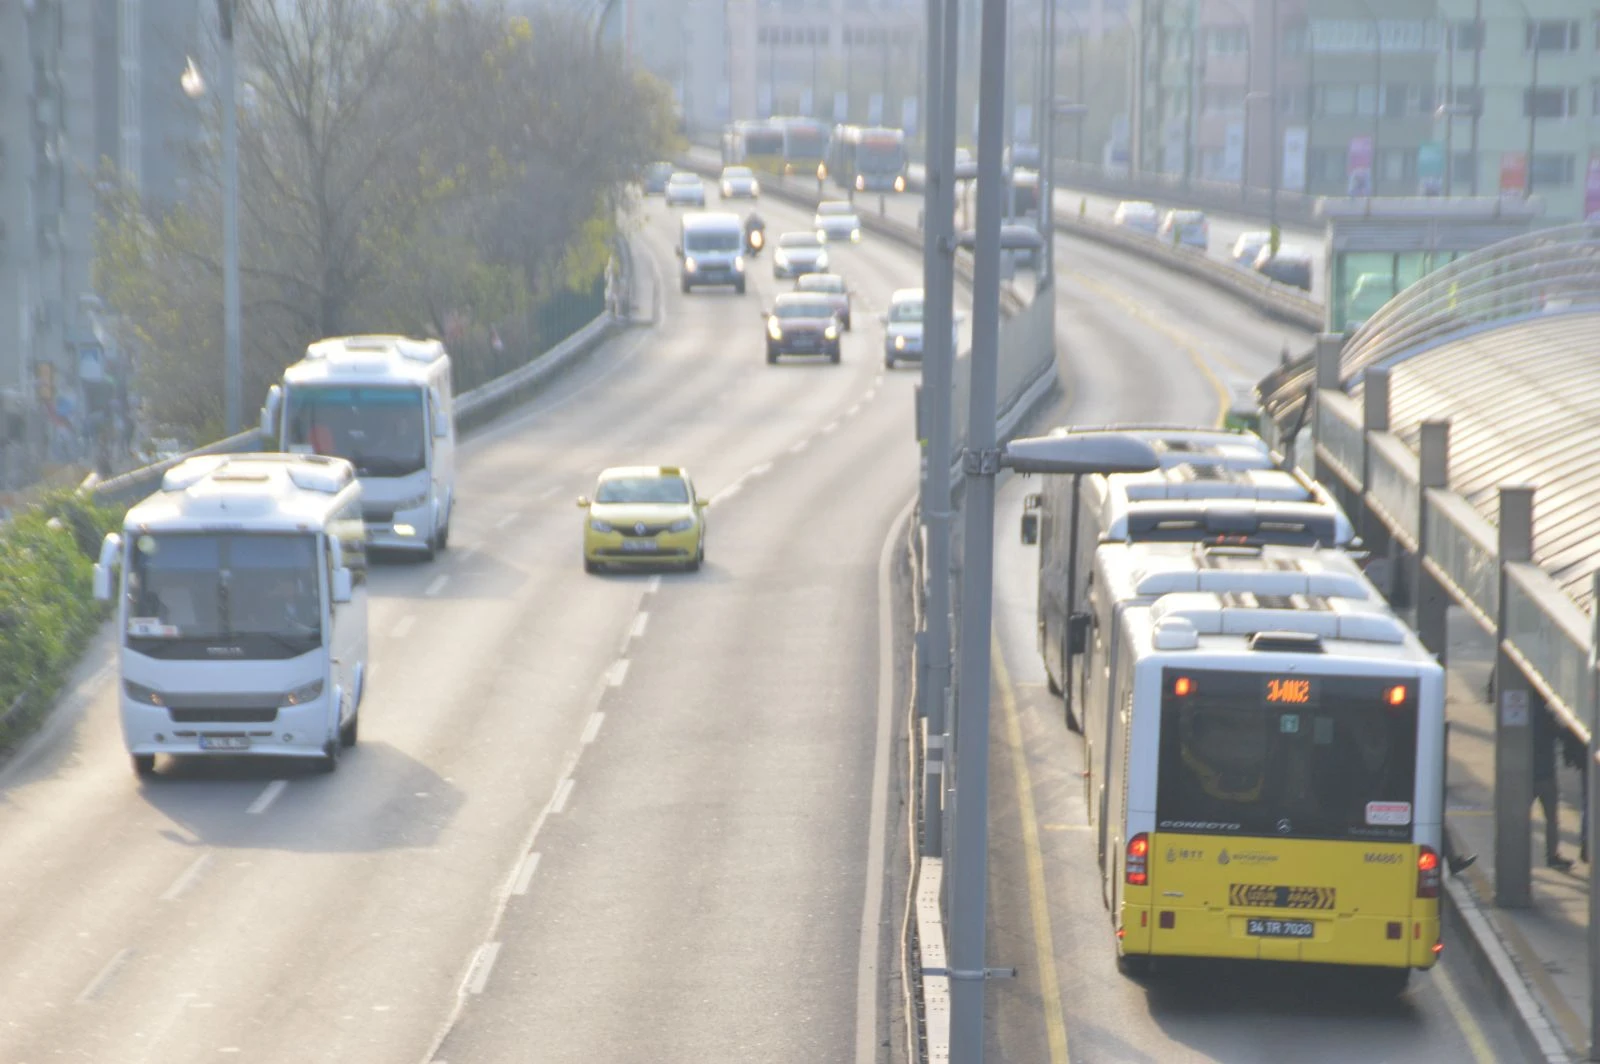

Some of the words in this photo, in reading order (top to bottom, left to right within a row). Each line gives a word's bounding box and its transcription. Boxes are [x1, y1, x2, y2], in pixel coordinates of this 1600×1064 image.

[1159, 820, 1241, 830] CONECTO
[1249, 921, 1264, 933] 34
[1266, 922, 1281, 934] TR
